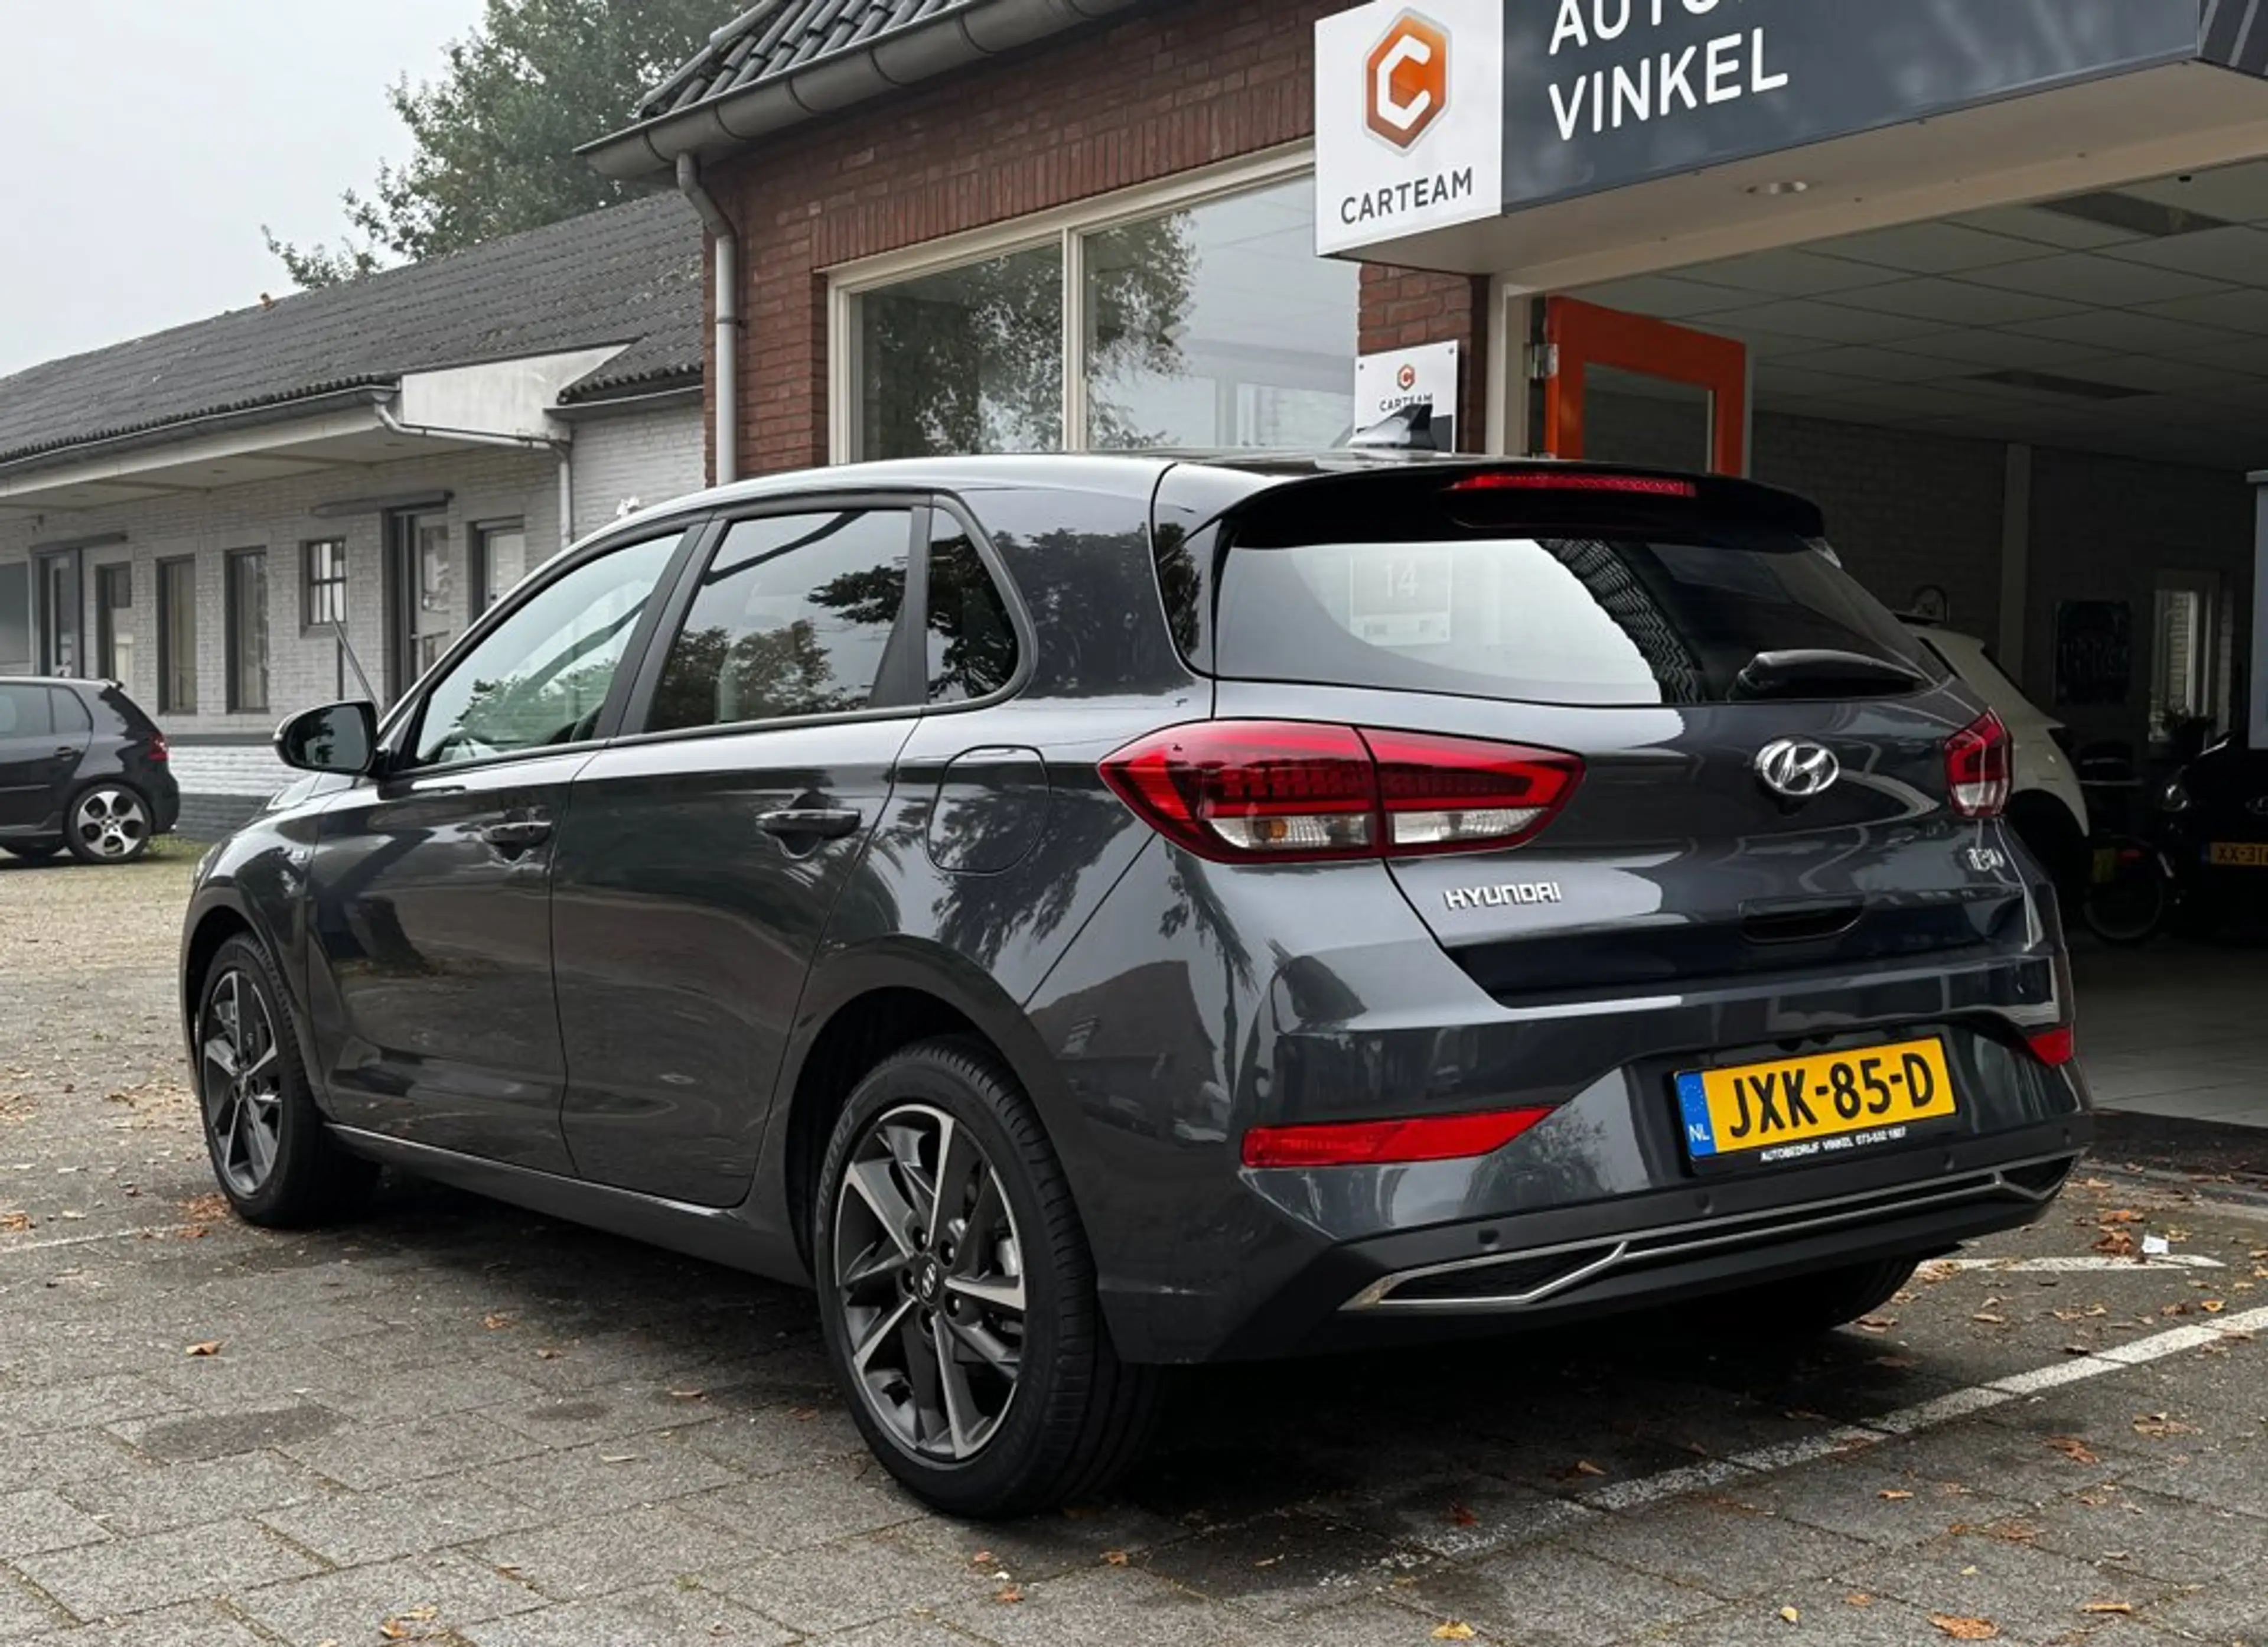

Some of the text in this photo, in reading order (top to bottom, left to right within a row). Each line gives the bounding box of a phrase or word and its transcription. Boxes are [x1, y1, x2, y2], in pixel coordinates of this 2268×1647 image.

[1548, 27, 1788, 141] VINKEL
[1340, 167, 1472, 225] CARTEAM
[1445, 881, 1562, 910] HYUNDAI
[1730, 1053, 1935, 1138] JXK-85-D
[1689, 1124, 1710, 1143] NL
